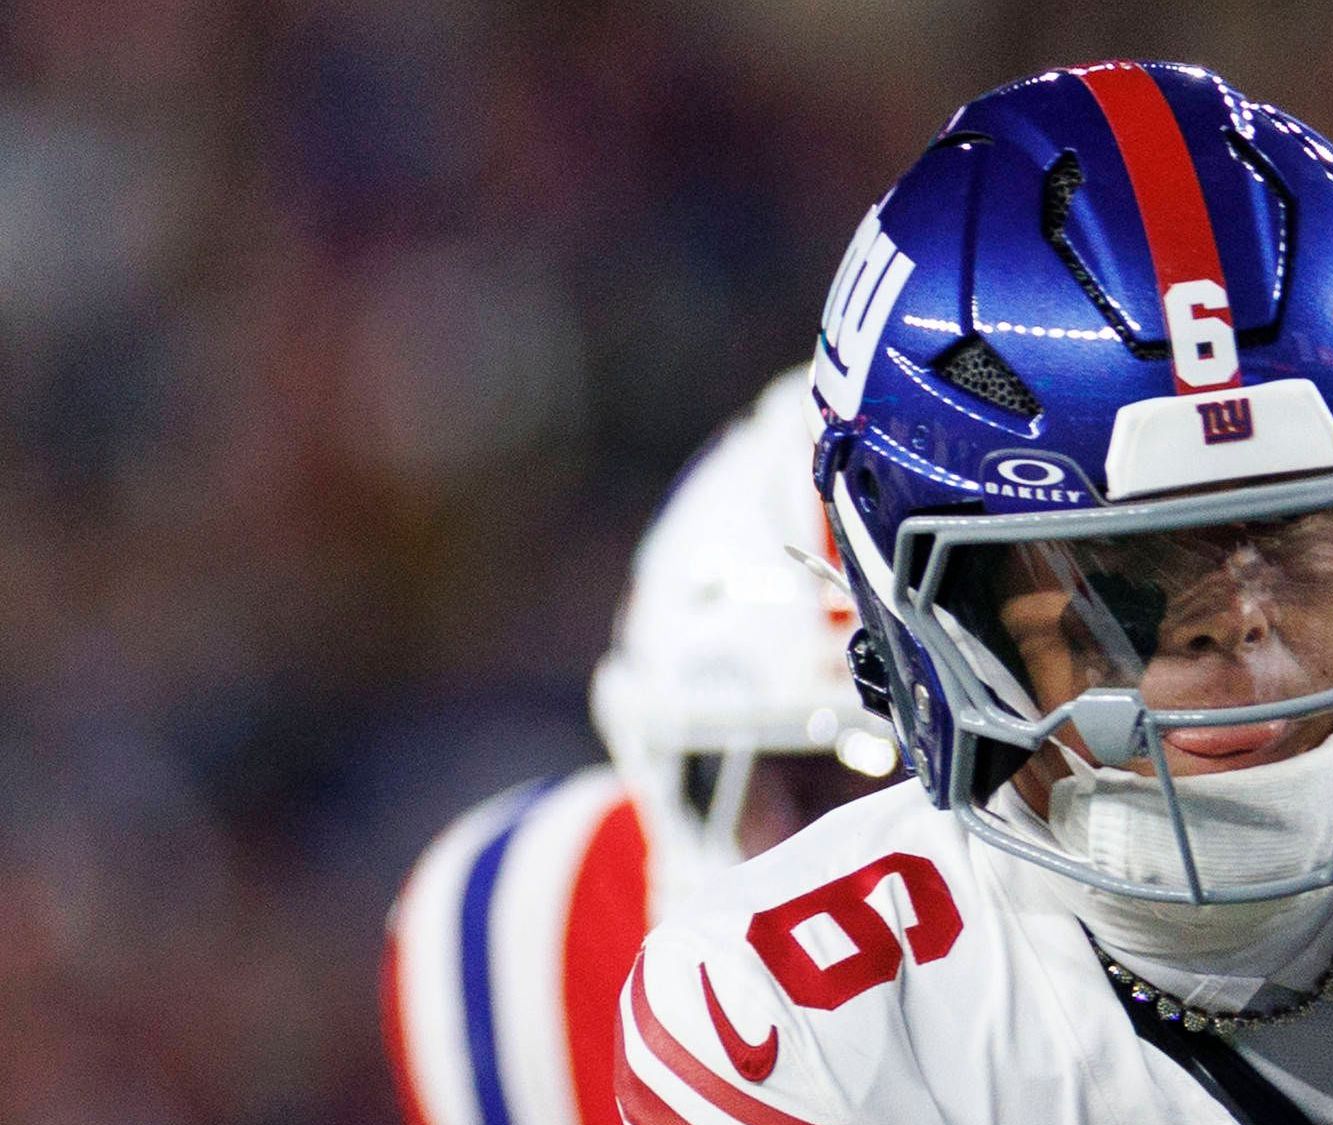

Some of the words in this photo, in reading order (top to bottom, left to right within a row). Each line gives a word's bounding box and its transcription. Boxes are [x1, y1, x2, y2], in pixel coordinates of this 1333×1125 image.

[1163, 279, 1240, 387] 6
[984, 482, 1082, 503] OAKLEY
[746, 852, 964, 1011] 6
